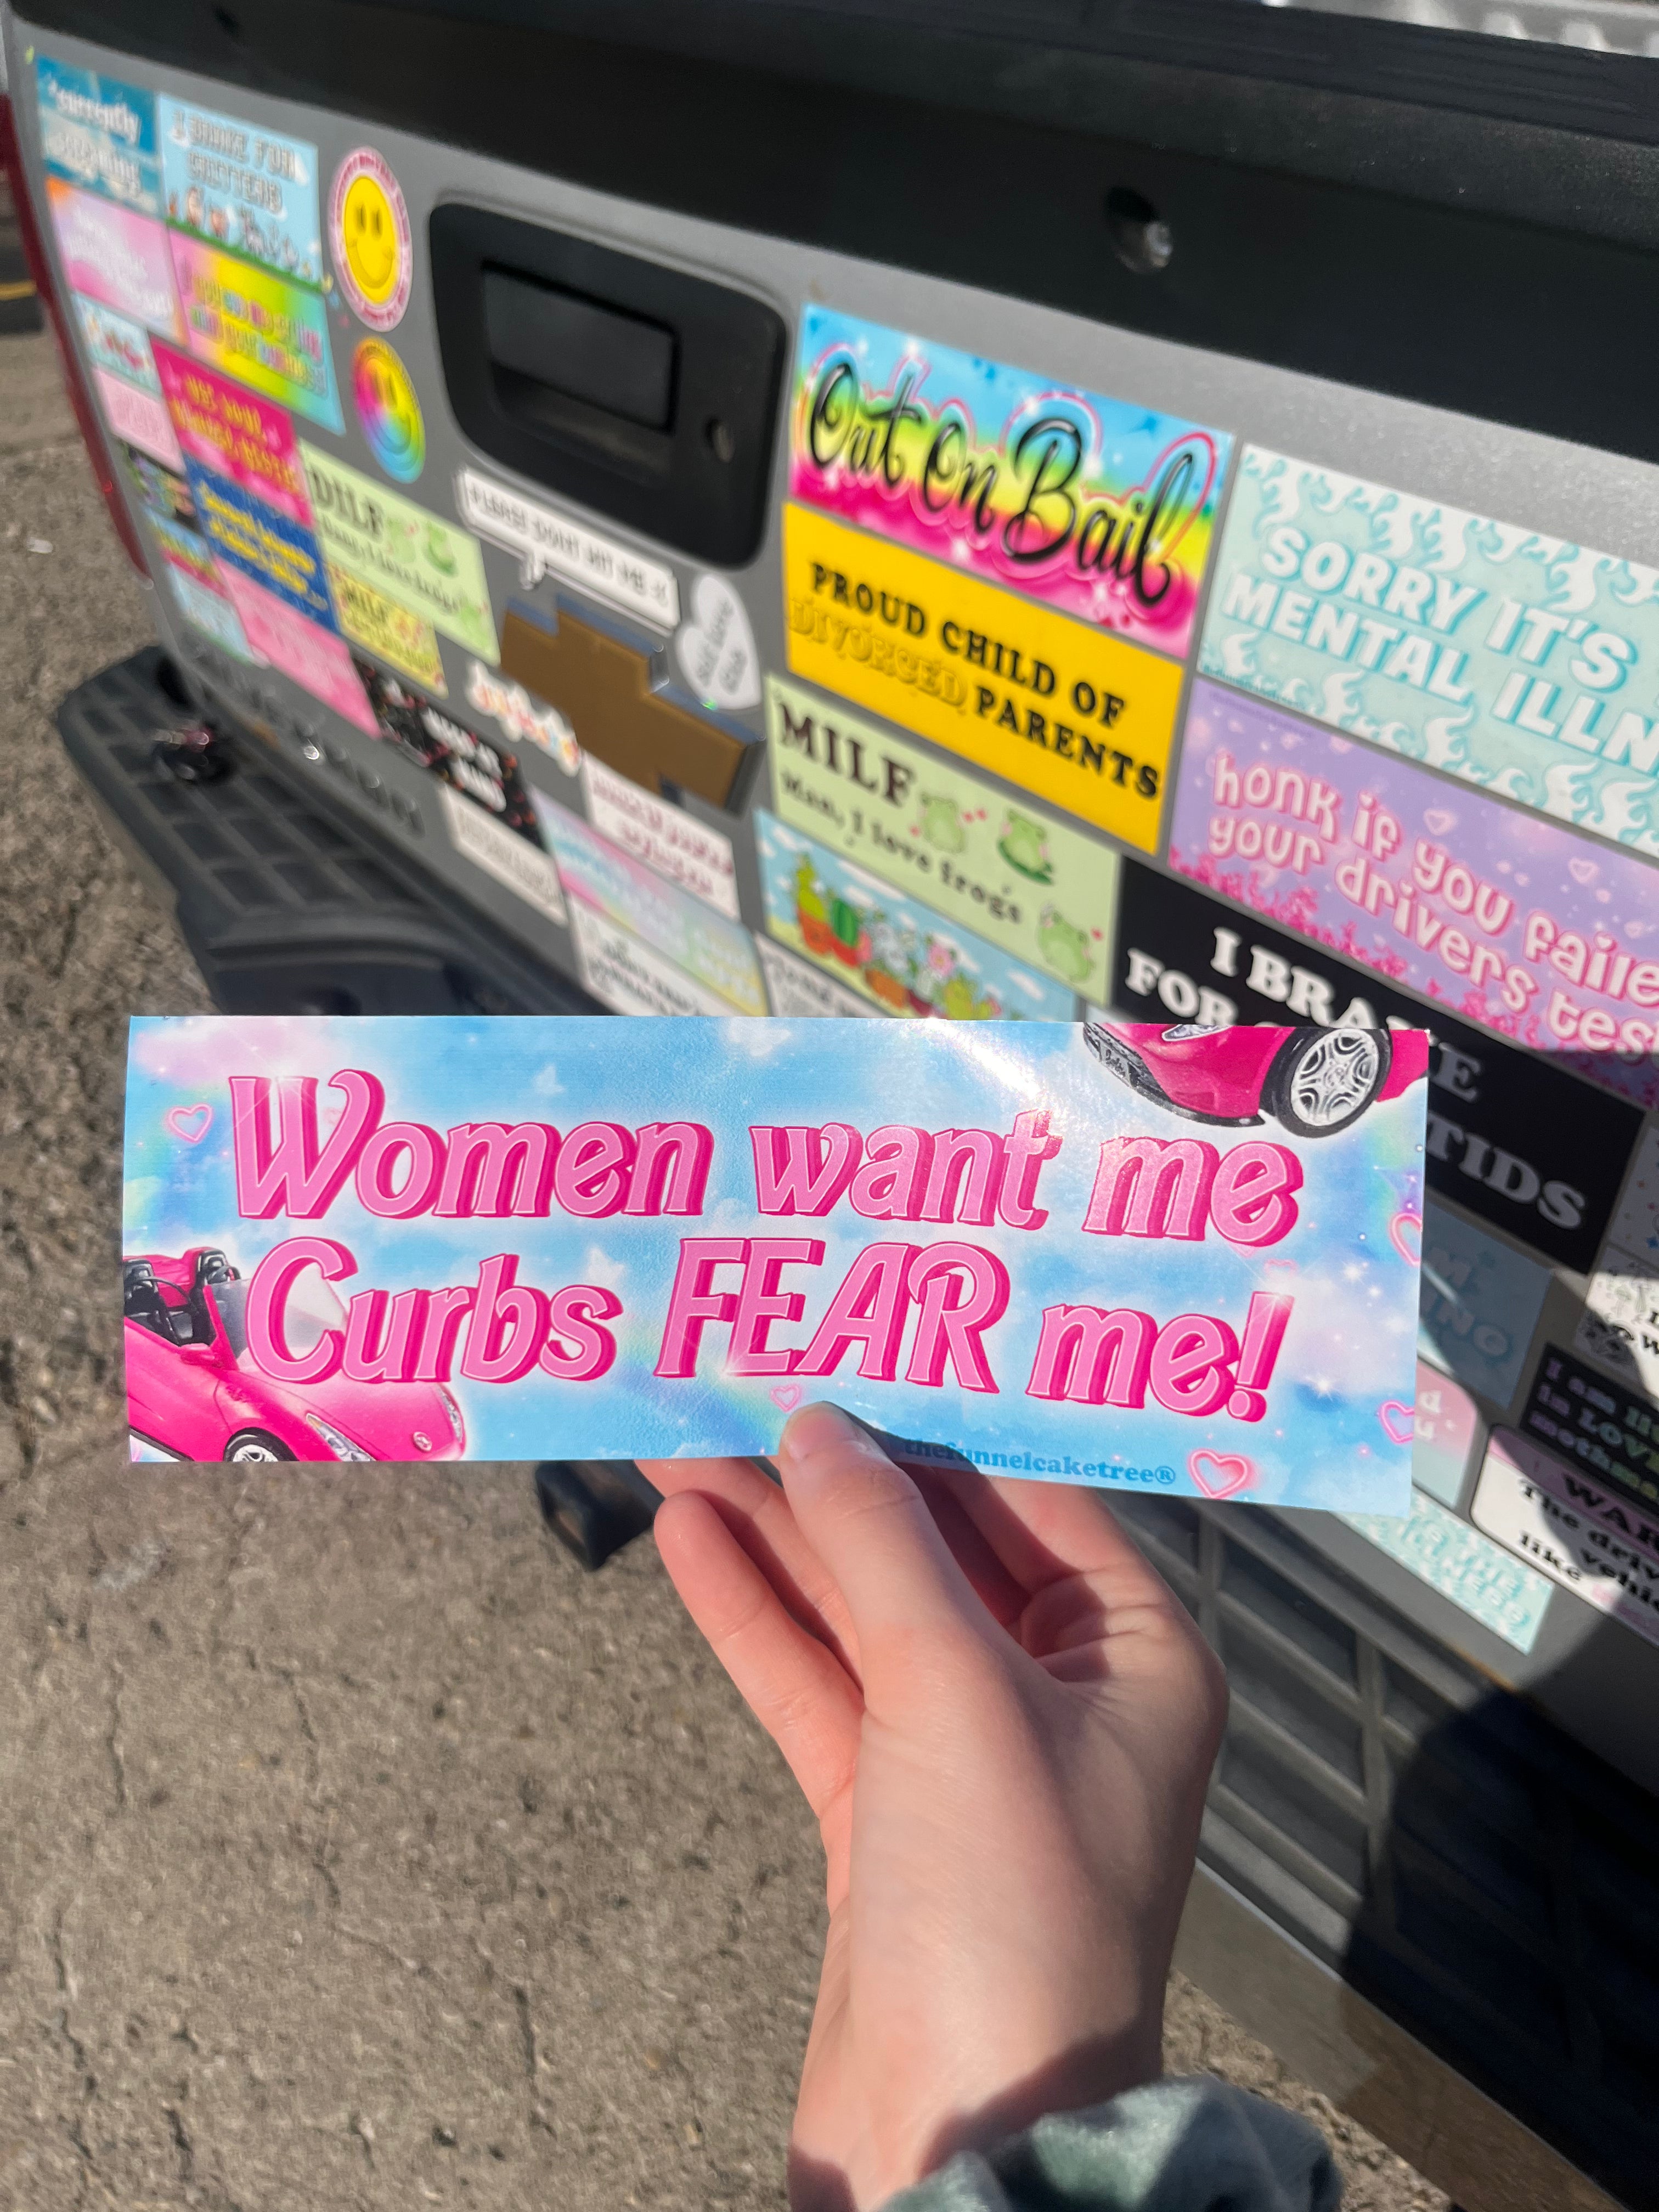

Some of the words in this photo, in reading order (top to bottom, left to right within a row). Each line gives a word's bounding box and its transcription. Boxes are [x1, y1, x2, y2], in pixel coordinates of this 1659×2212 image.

[310, 467, 384, 543] DILF
[809, 362, 924, 488] Out
[923, 421, 996, 535] On
[1002, 418, 1194, 607] Bail
[811, 561, 927, 637] PROUD
[940, 620, 1057, 698] CHILD
[1071, 681, 1126, 729] OF
[1221, 574, 1476, 708] MENTAL
[1490, 669, 1659, 778] ILLN
[1260, 527, 1487, 634] SORRY
[1485, 596, 1639, 693] IT'S
[779, 702, 915, 808] MILF
[789, 599, 968, 711] DIVORCED
[975, 685, 1160, 801] PARENTS
[871, 822, 931, 873] love
[939, 860, 1022, 925] frogs
[1208, 813, 1324, 877] your
[1335, 856, 1539, 1017] drivers
[1212, 752, 1343, 845] honk
[1351, 789, 1402, 862] if
[1413, 834, 1515, 935] you
[1125, 947, 1239, 1026] FOR
[1209, 926, 1243, 978] I
[1245, 944, 1482, 1103] BRAE
[229, 1069, 713, 1219] Women
[748, 1108, 1062, 1231] want
[1082, 1134, 1304, 1247] me
[247, 1237, 622, 1384] Curbs
[654, 1237, 1010, 1394] FEAR
[1025, 1290, 1295, 1423] me!
[1519, 1530, 1583, 1581] like
